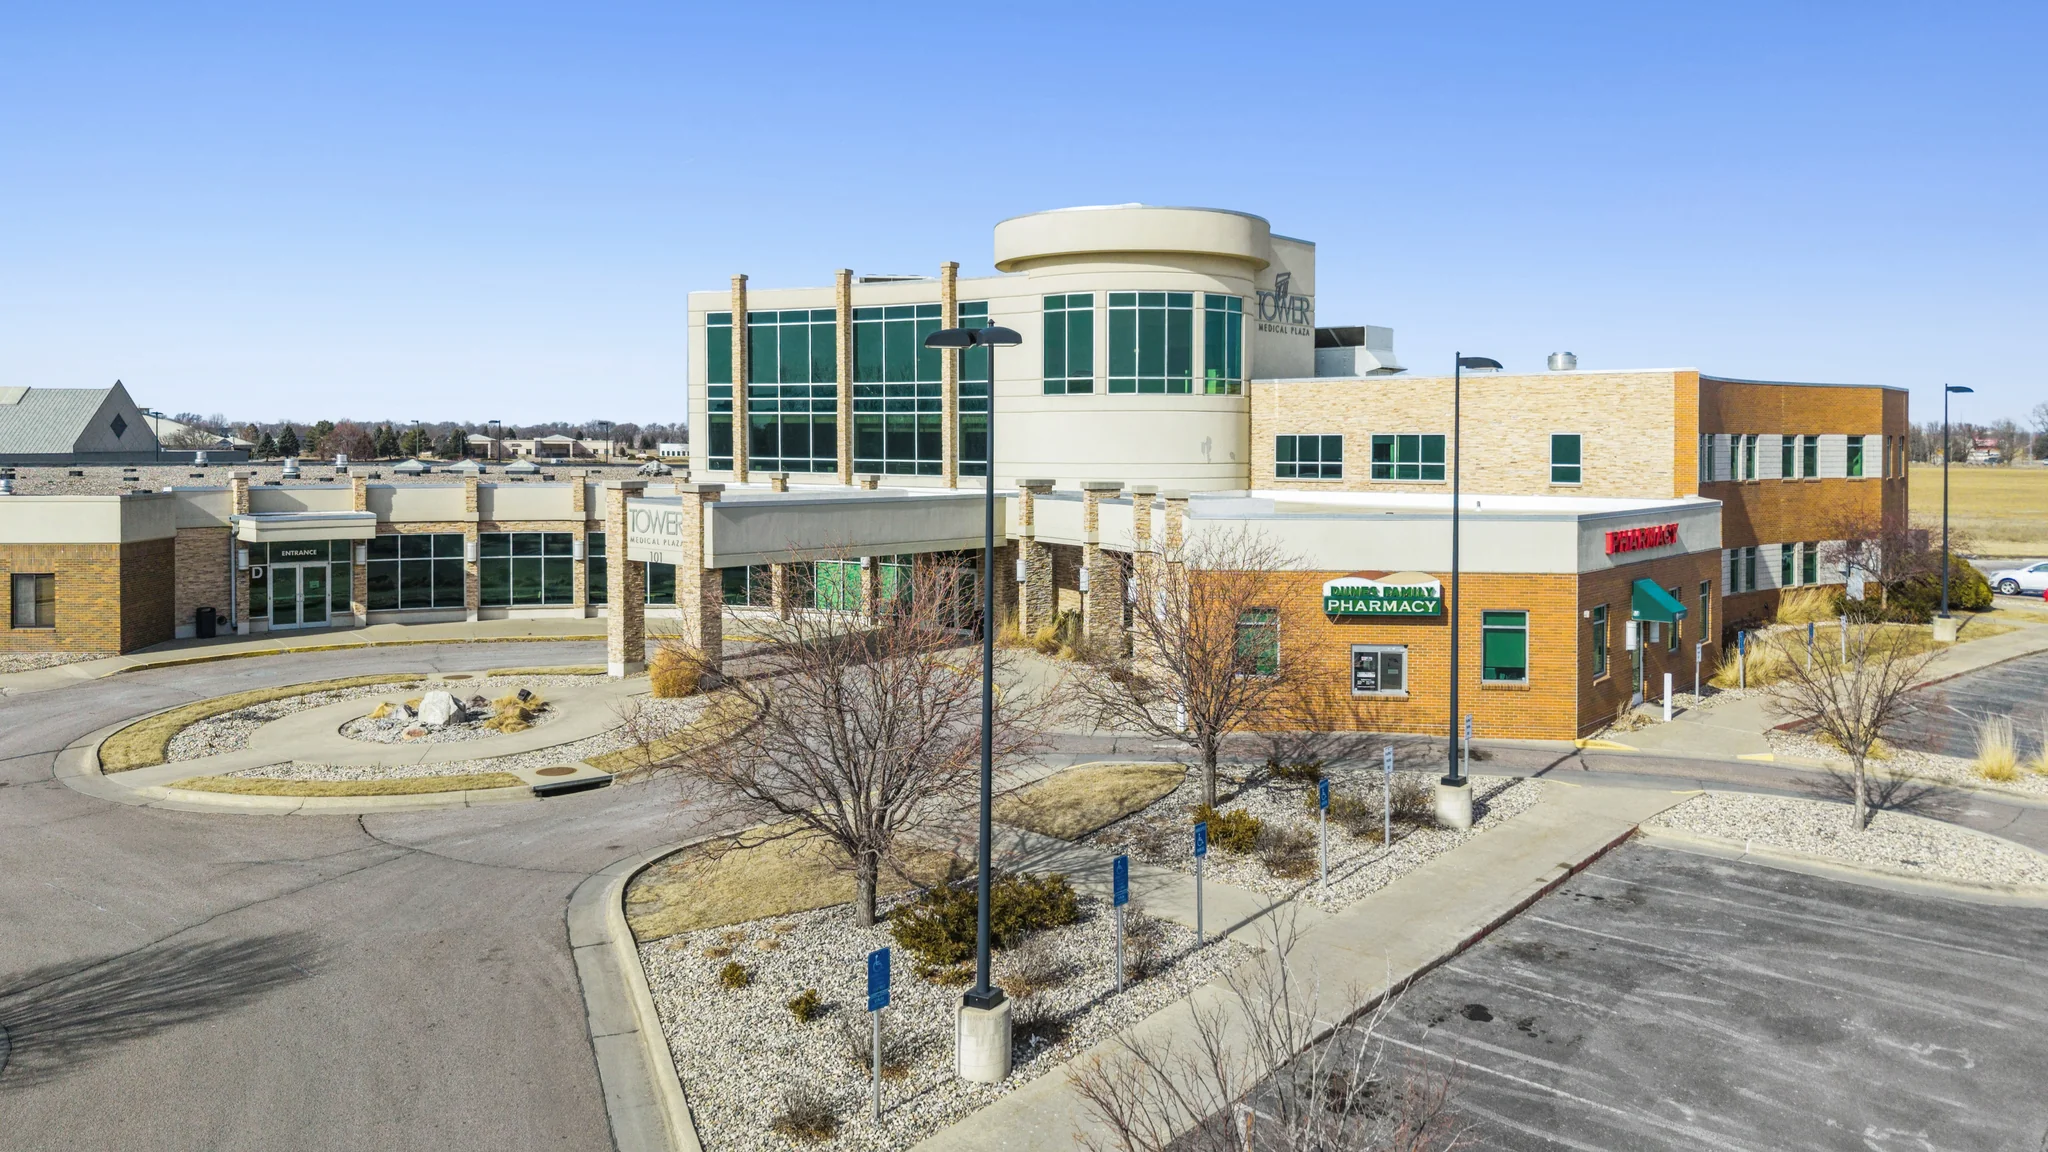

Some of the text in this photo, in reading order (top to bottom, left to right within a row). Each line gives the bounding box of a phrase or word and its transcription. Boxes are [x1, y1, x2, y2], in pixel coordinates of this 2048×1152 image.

[1256, 290, 1310, 325] TOWER
[1258, 323, 1310, 336] MEDICAL PLAZA
[629, 508, 683, 536] TOWER
[630, 536, 660, 546] MEDICAL
[1605, 523, 1679, 555] PHARMACY
[649, 551, 663, 563] 101
[251, 566, 264, 579] D
[1330, 586, 1436, 598] DUNES FAMILY
[1327, 599, 1437, 613] PHARMACY
